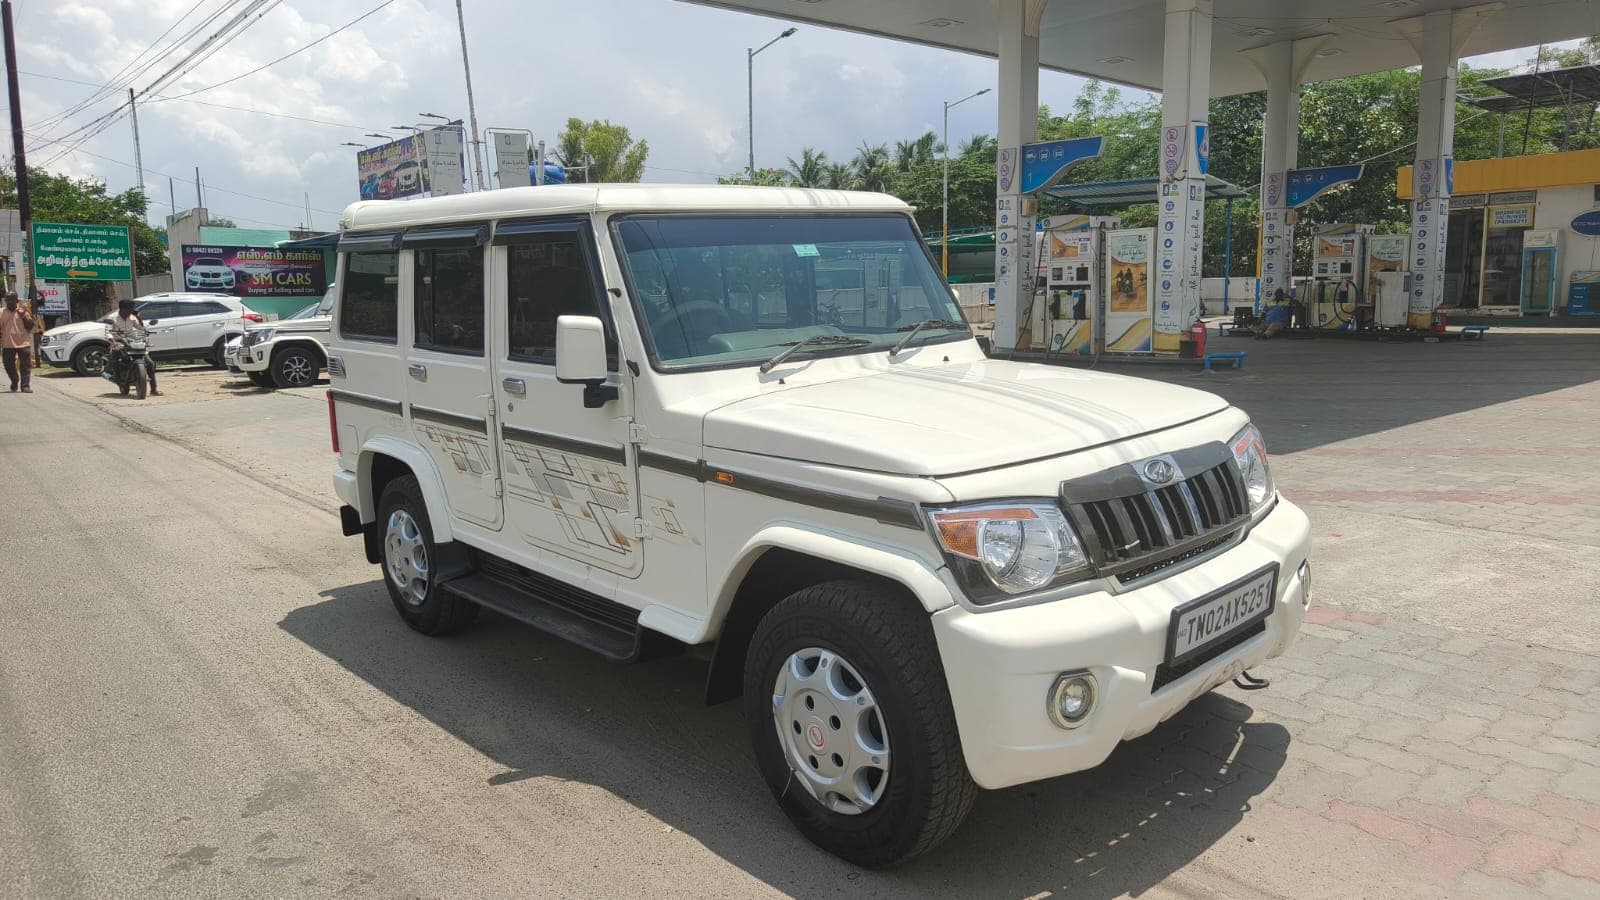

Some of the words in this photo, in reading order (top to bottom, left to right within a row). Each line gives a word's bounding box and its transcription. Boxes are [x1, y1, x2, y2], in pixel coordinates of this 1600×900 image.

[252, 272, 273, 285] SM
[276, 272, 312, 285] CARS
[1187, 580, 1271, 645] TN02AX5251
